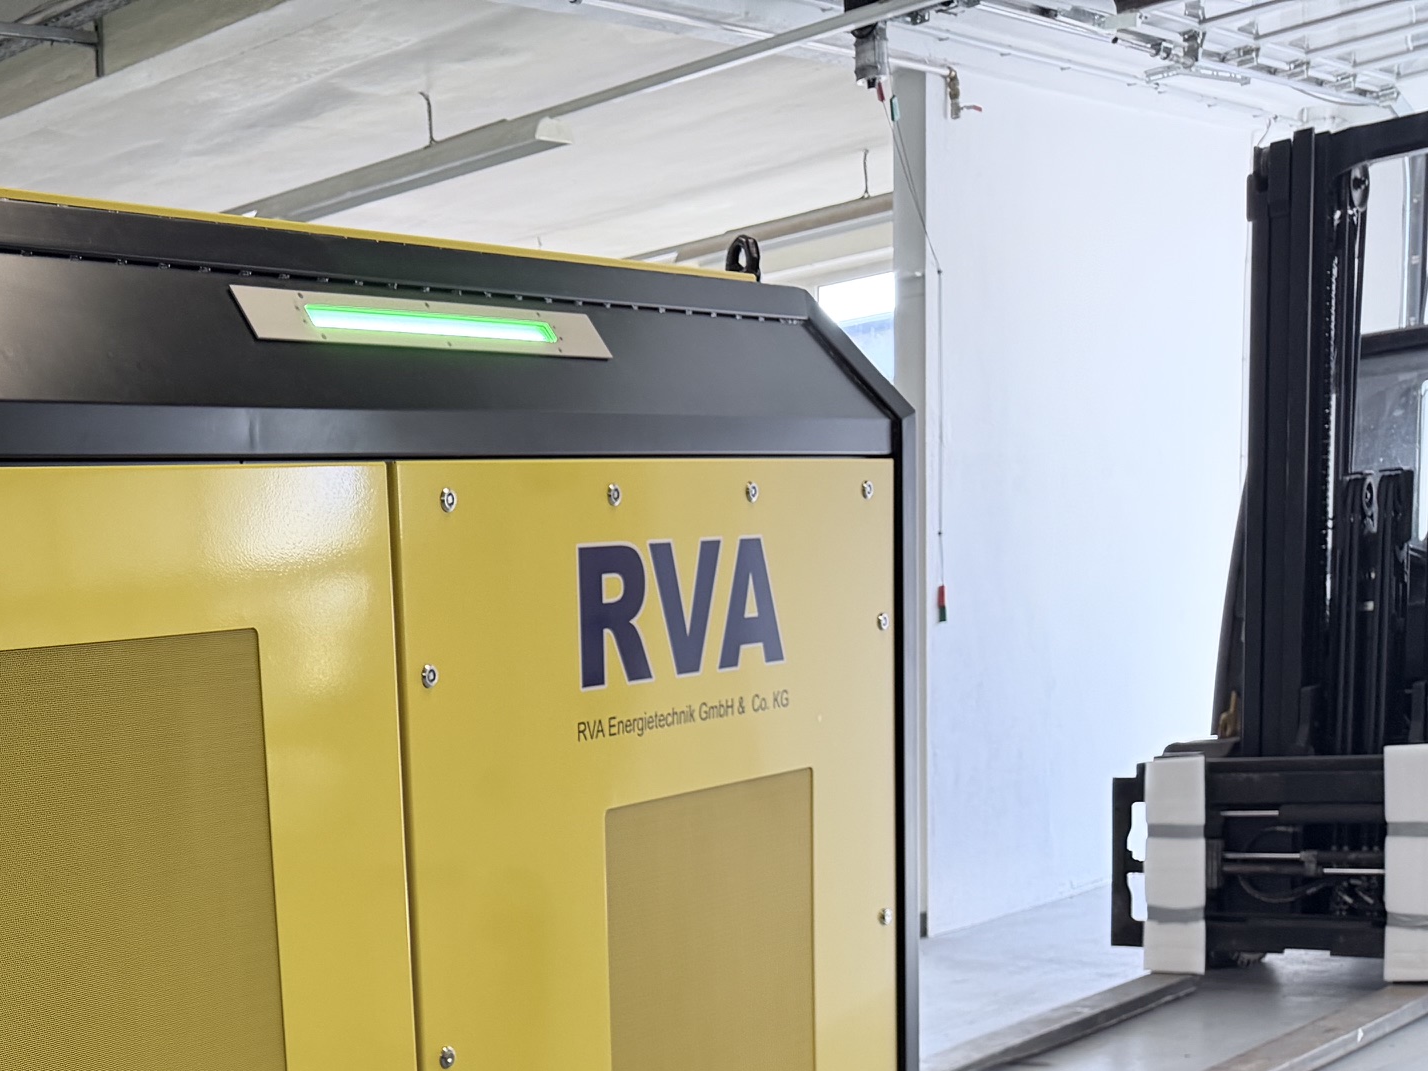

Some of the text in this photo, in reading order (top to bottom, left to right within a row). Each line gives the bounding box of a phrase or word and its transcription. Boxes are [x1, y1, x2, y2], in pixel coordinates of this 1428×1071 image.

[576, 534, 785, 691] RVA
[577, 689, 789, 742] RVA Energietechnik GmbH & Co. KG
